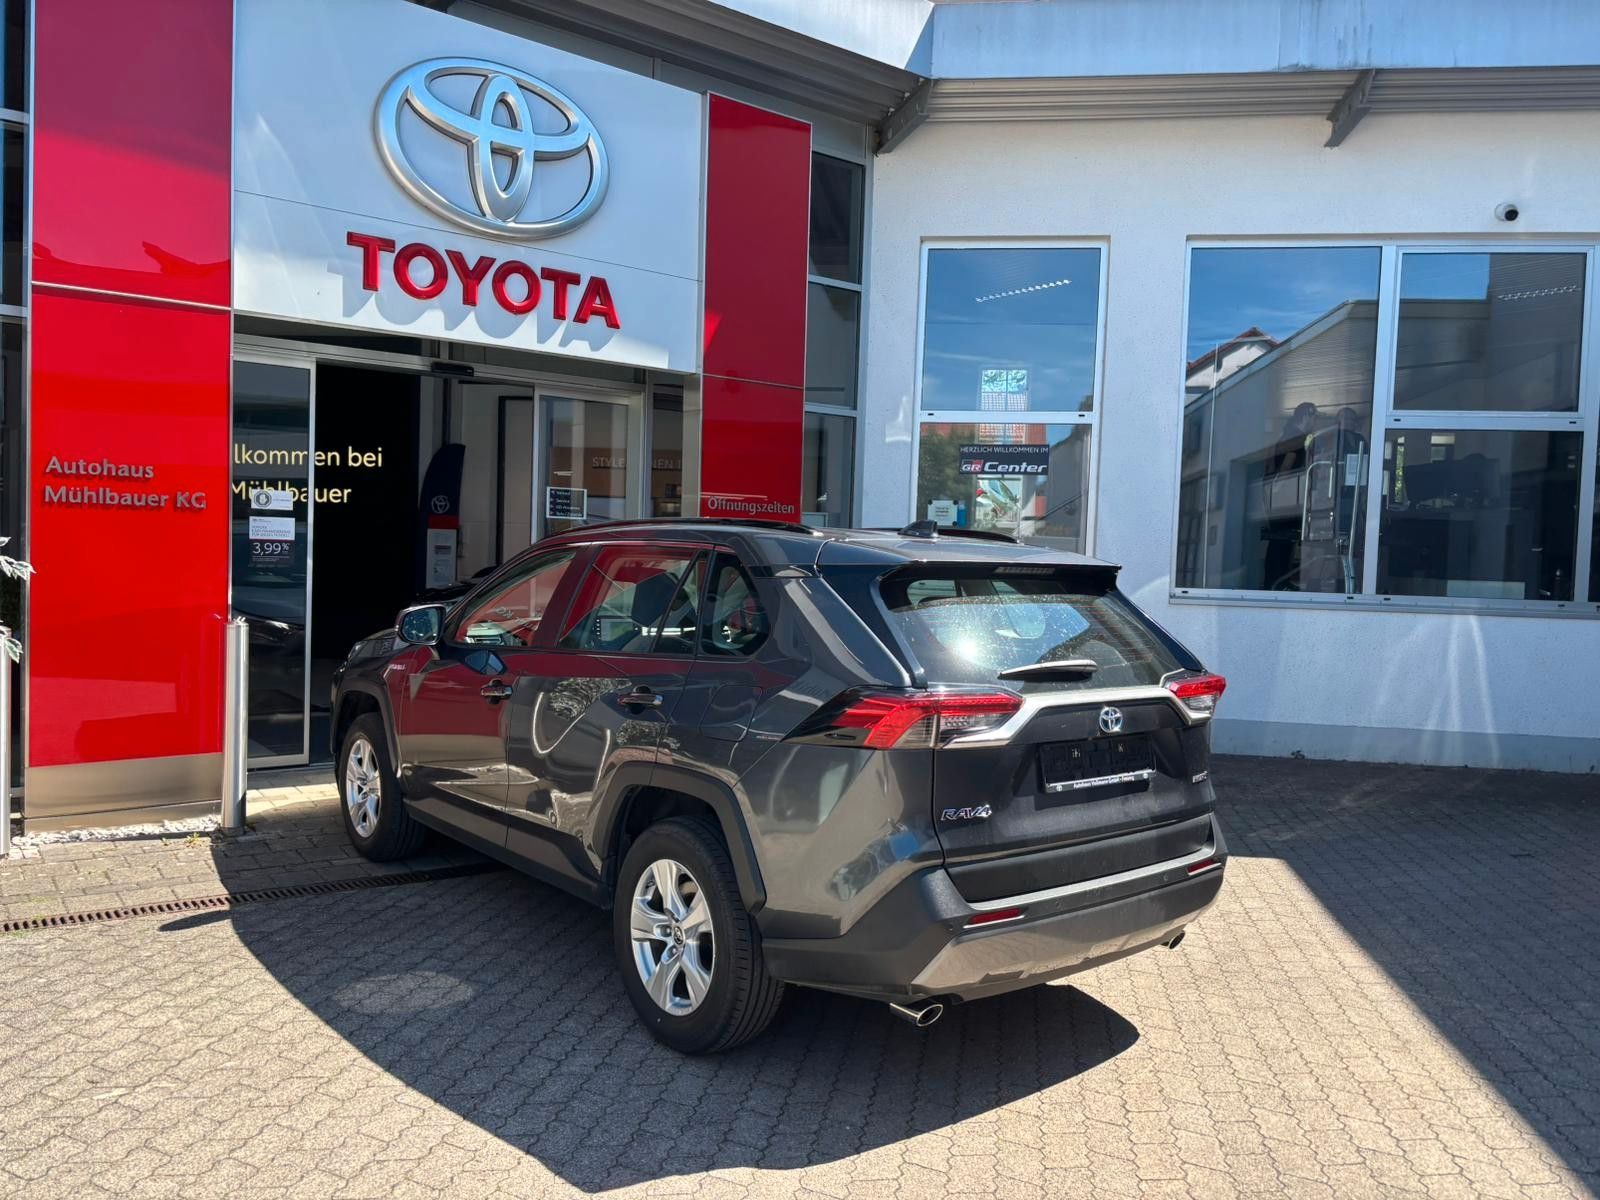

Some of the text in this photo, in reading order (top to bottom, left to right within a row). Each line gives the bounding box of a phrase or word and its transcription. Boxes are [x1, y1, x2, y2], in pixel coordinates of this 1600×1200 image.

[346, 231, 621, 329] TOYOTA
[234, 443, 383, 467] lkommen bei
[994, 446, 1039, 454] WILLKOMMEN
[45, 455, 155, 479] Autohaus
[961, 461, 1048, 473] GR Center
[44, 485, 207, 509] Mühlbauer KG
[707, 495, 795, 515] Öffnungszeiten
[940, 804, 992, 821] RAV4
